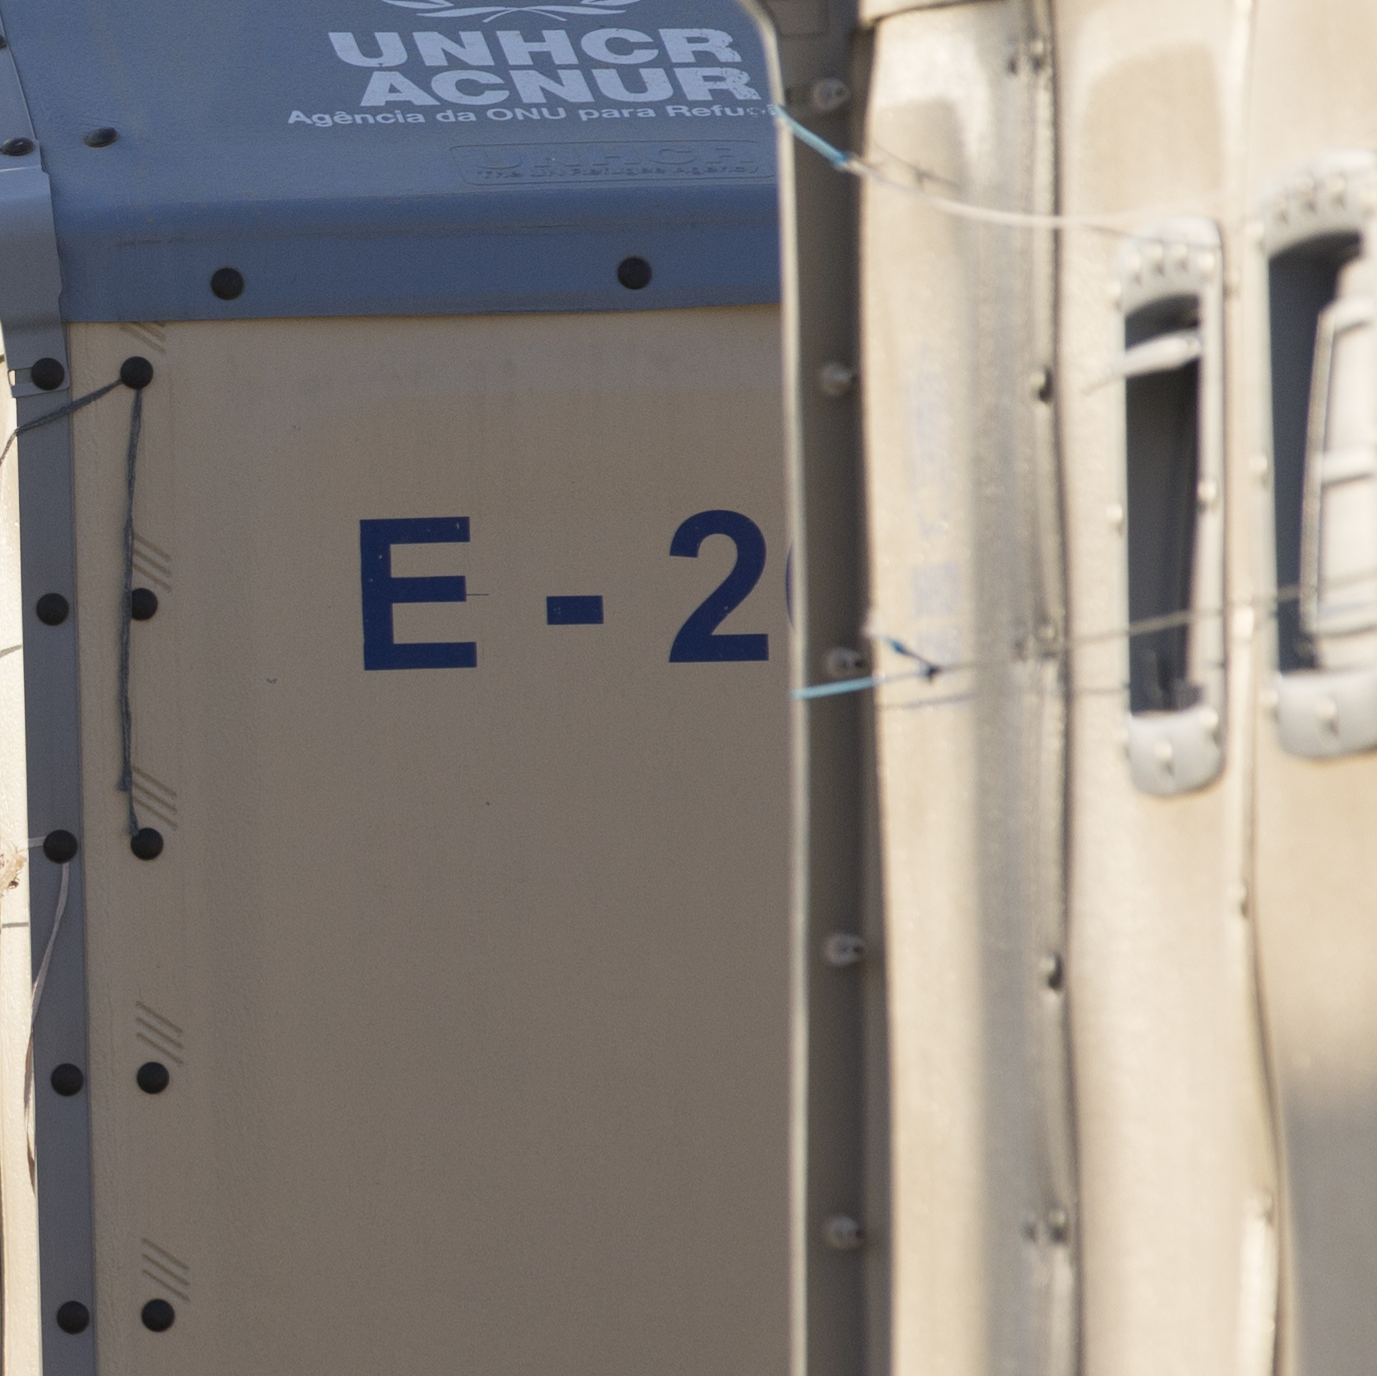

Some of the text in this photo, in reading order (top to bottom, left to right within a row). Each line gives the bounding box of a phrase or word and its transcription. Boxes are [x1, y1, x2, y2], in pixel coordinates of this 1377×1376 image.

[327, 27, 742, 67] UNHCR
[359, 66, 763, 107] ACNUR
[286, 109, 427, 128] Agência
[435, 108, 477, 123] da
[486, 106, 567, 121] ONU
[577, 106, 657, 122] para
[359, 508, 796, 672] E - 2
